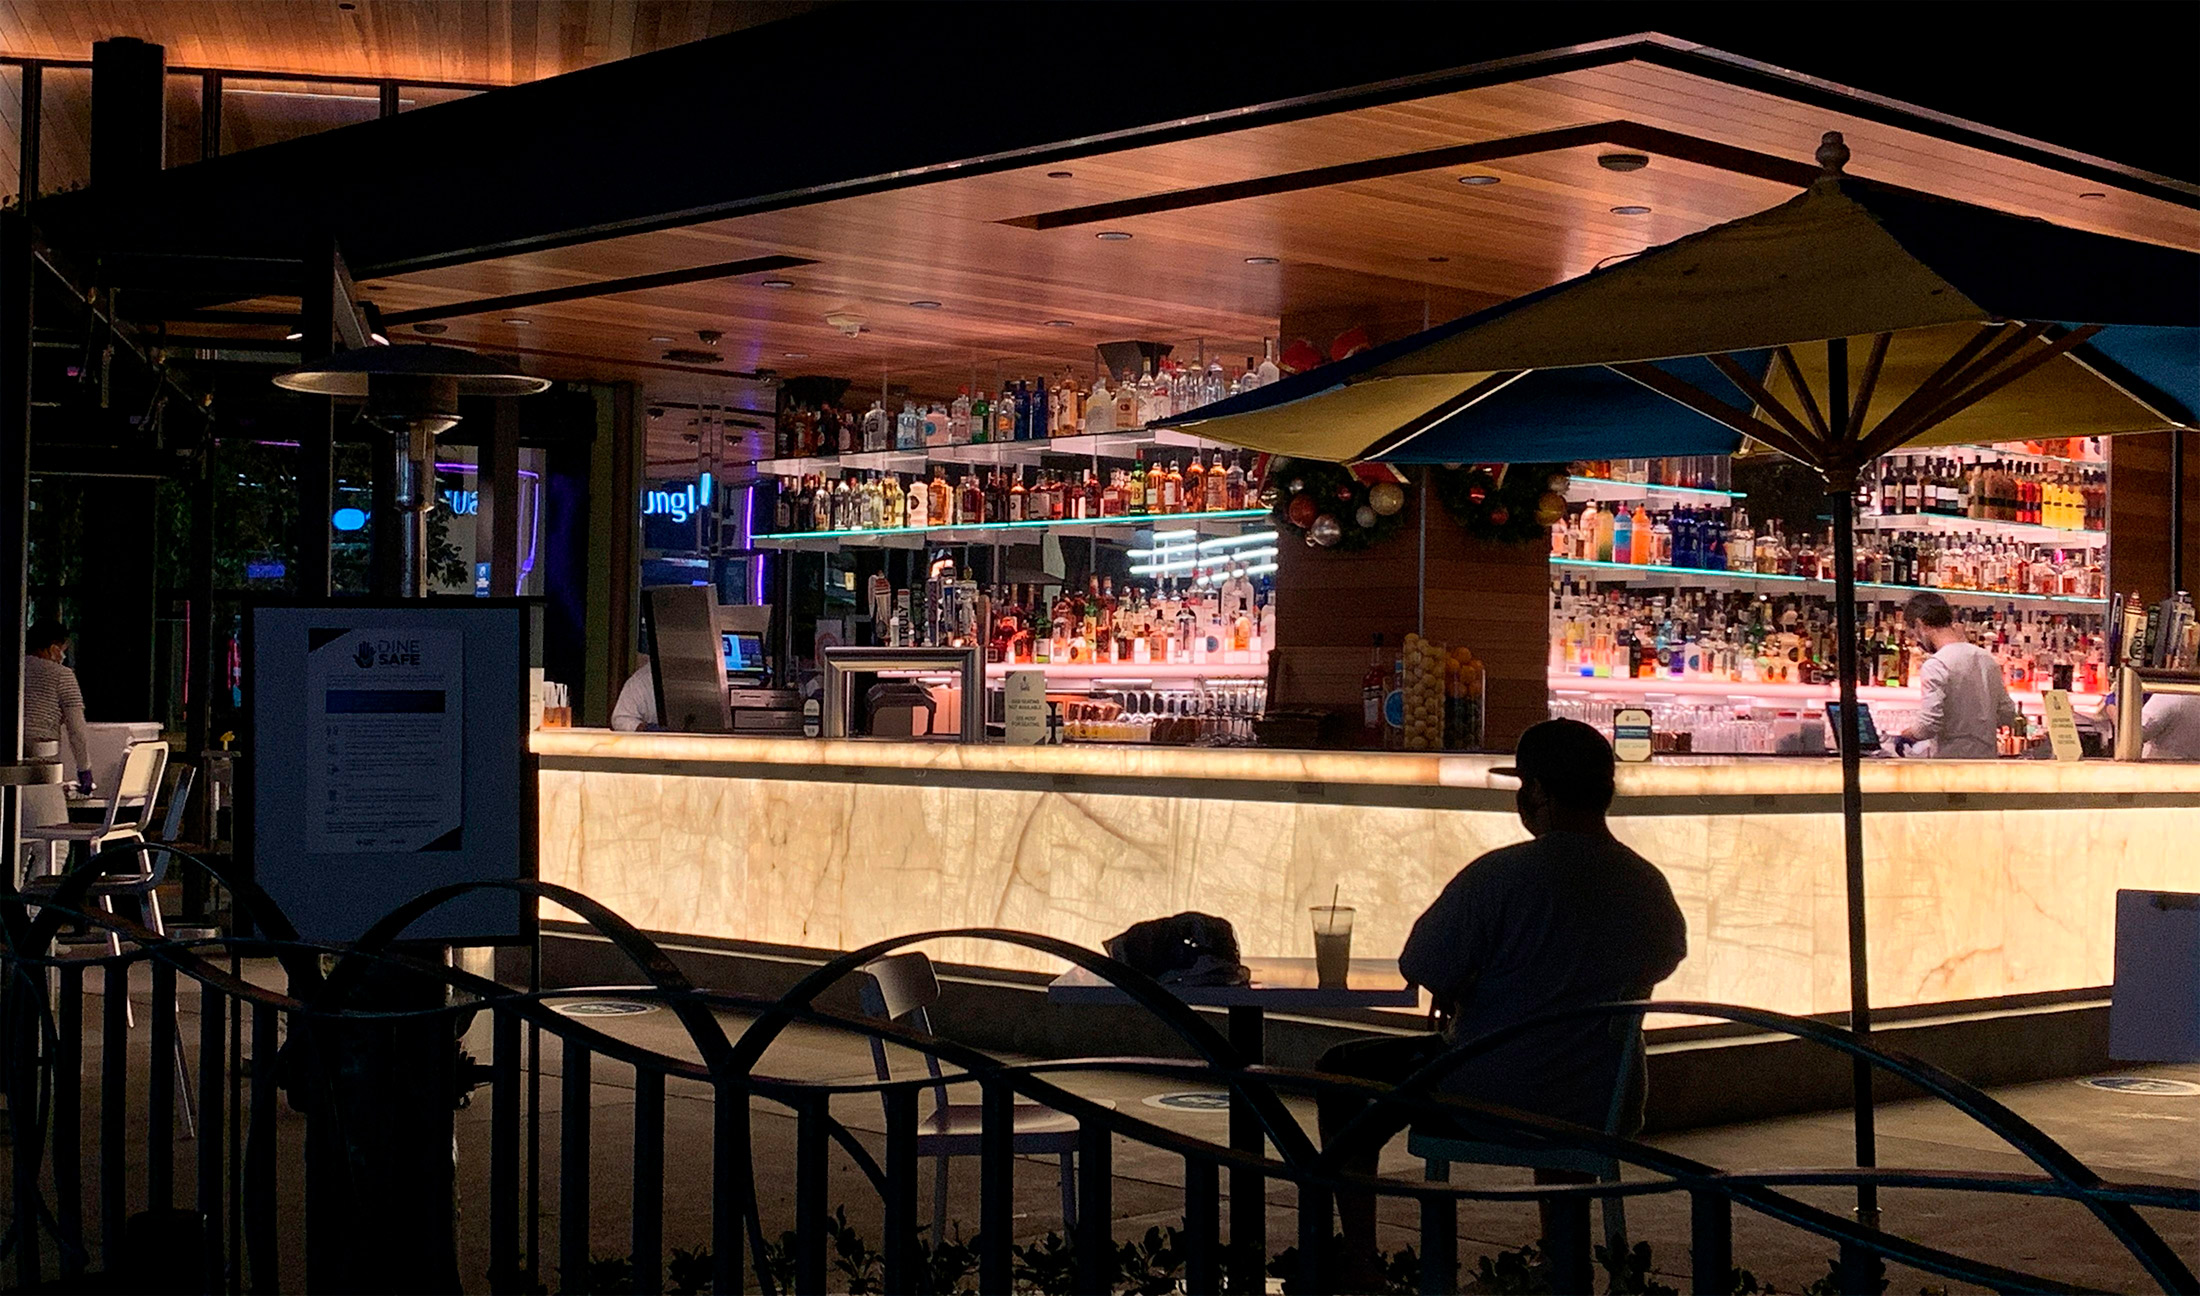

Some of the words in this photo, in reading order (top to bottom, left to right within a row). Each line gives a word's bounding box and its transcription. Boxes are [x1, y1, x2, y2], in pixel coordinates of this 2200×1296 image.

[899, 605, 909, 642] TRULY
[378, 640, 420, 653] DINE
[378, 653, 420, 666] SAFE
